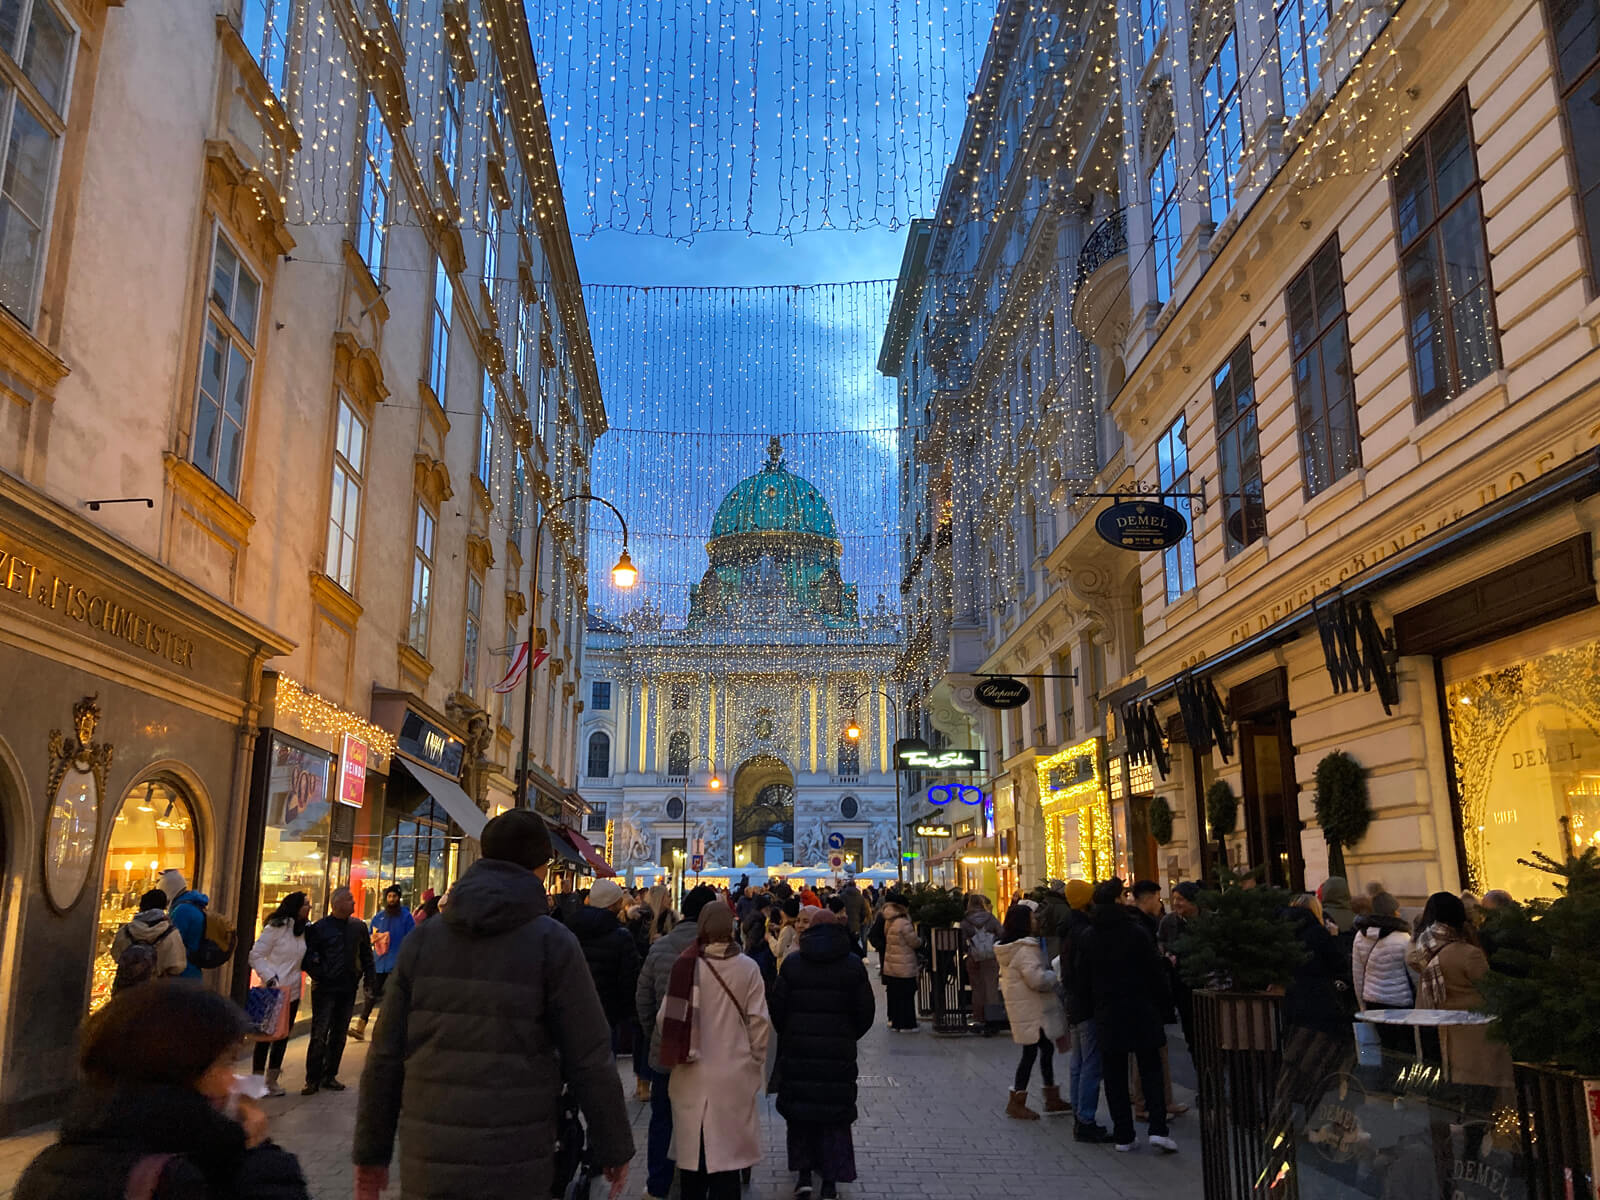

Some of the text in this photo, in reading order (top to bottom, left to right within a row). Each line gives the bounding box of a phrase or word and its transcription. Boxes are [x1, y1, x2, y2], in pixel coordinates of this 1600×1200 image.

[1116, 515, 1168, 529] DEMEL
[38, 586, 48, 605] &
[51, 576, 195, 670] FISCHMEISTER
[1513, 742, 1581, 770] DEMEL
[345, 760, 364, 779] HEINDL
